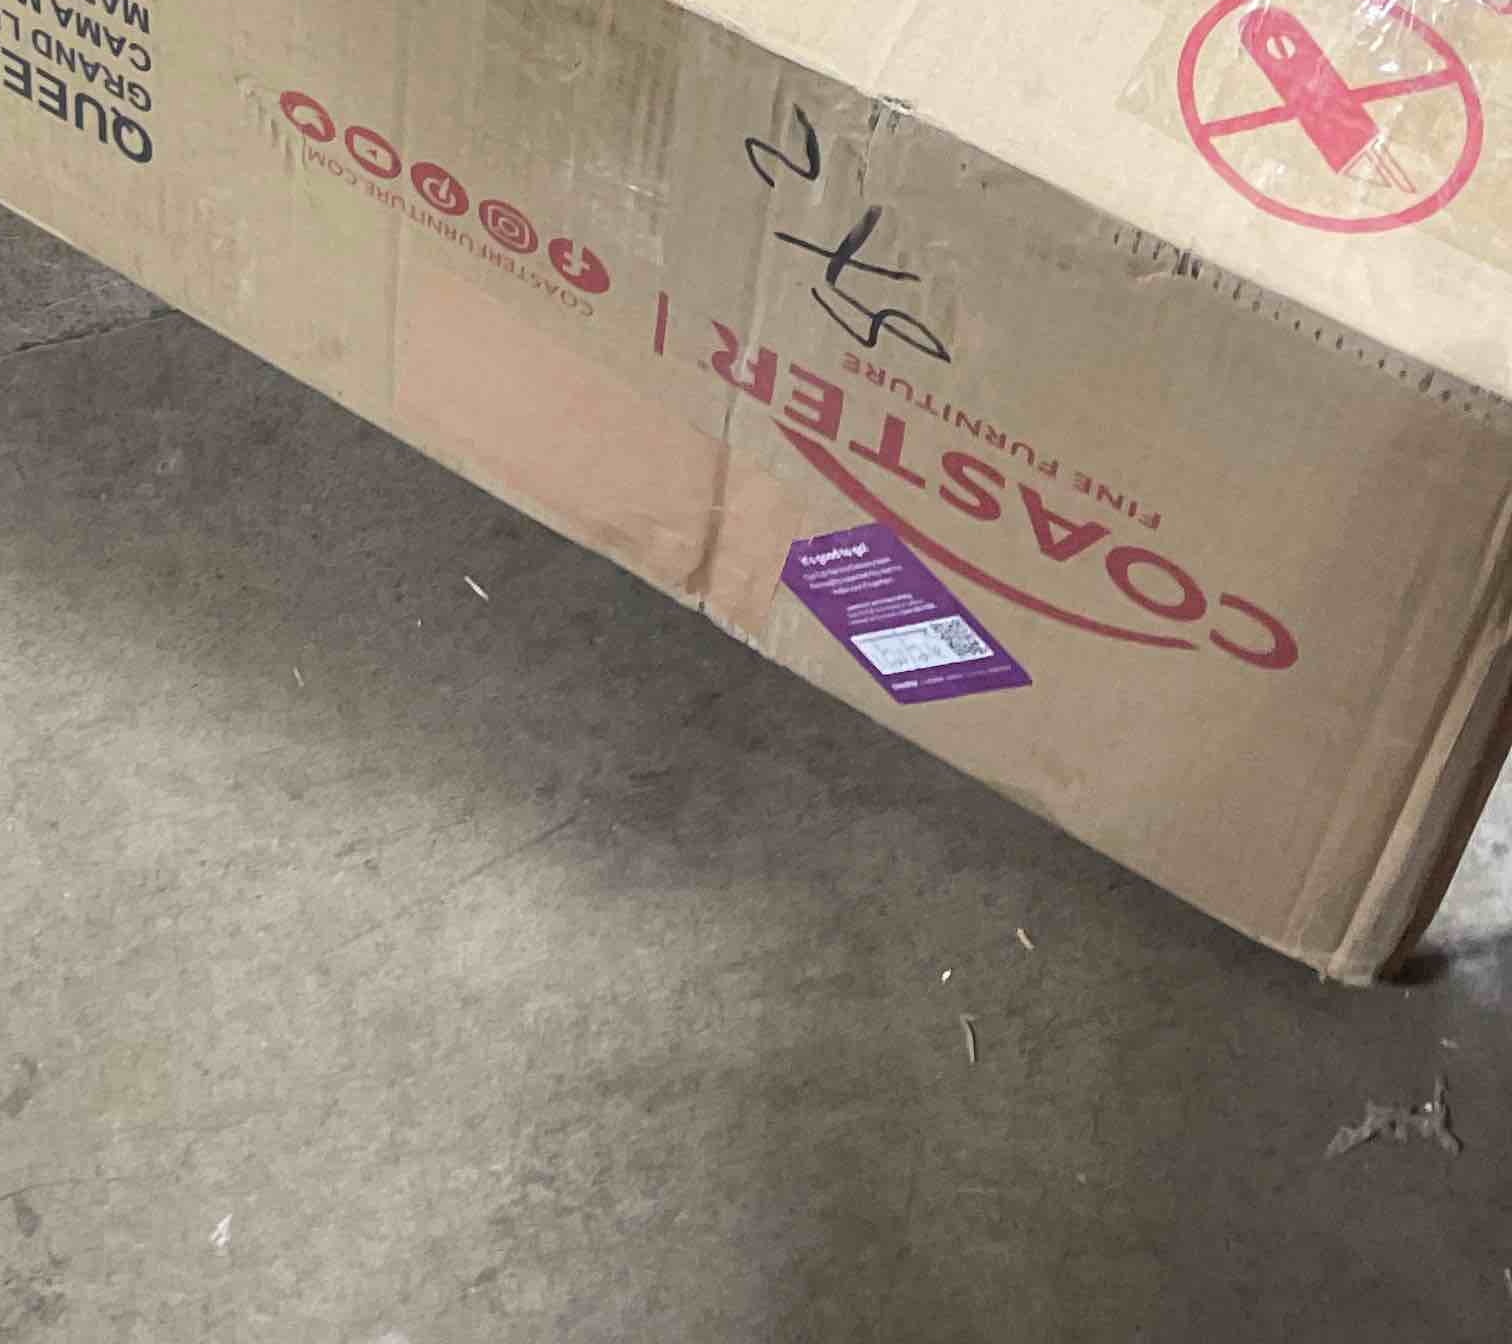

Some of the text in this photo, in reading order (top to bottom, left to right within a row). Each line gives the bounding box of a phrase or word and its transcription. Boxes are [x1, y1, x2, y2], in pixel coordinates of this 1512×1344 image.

[31, 31, 152, 112] GRAND
[53, 4, 152, 72] CAMA
[306, 146, 594, 317] COASTERFURNITURE.COM
[711, 318, 1299, 671] COASTER
[840, 351, 1163, 531] FINE FURNITURE
